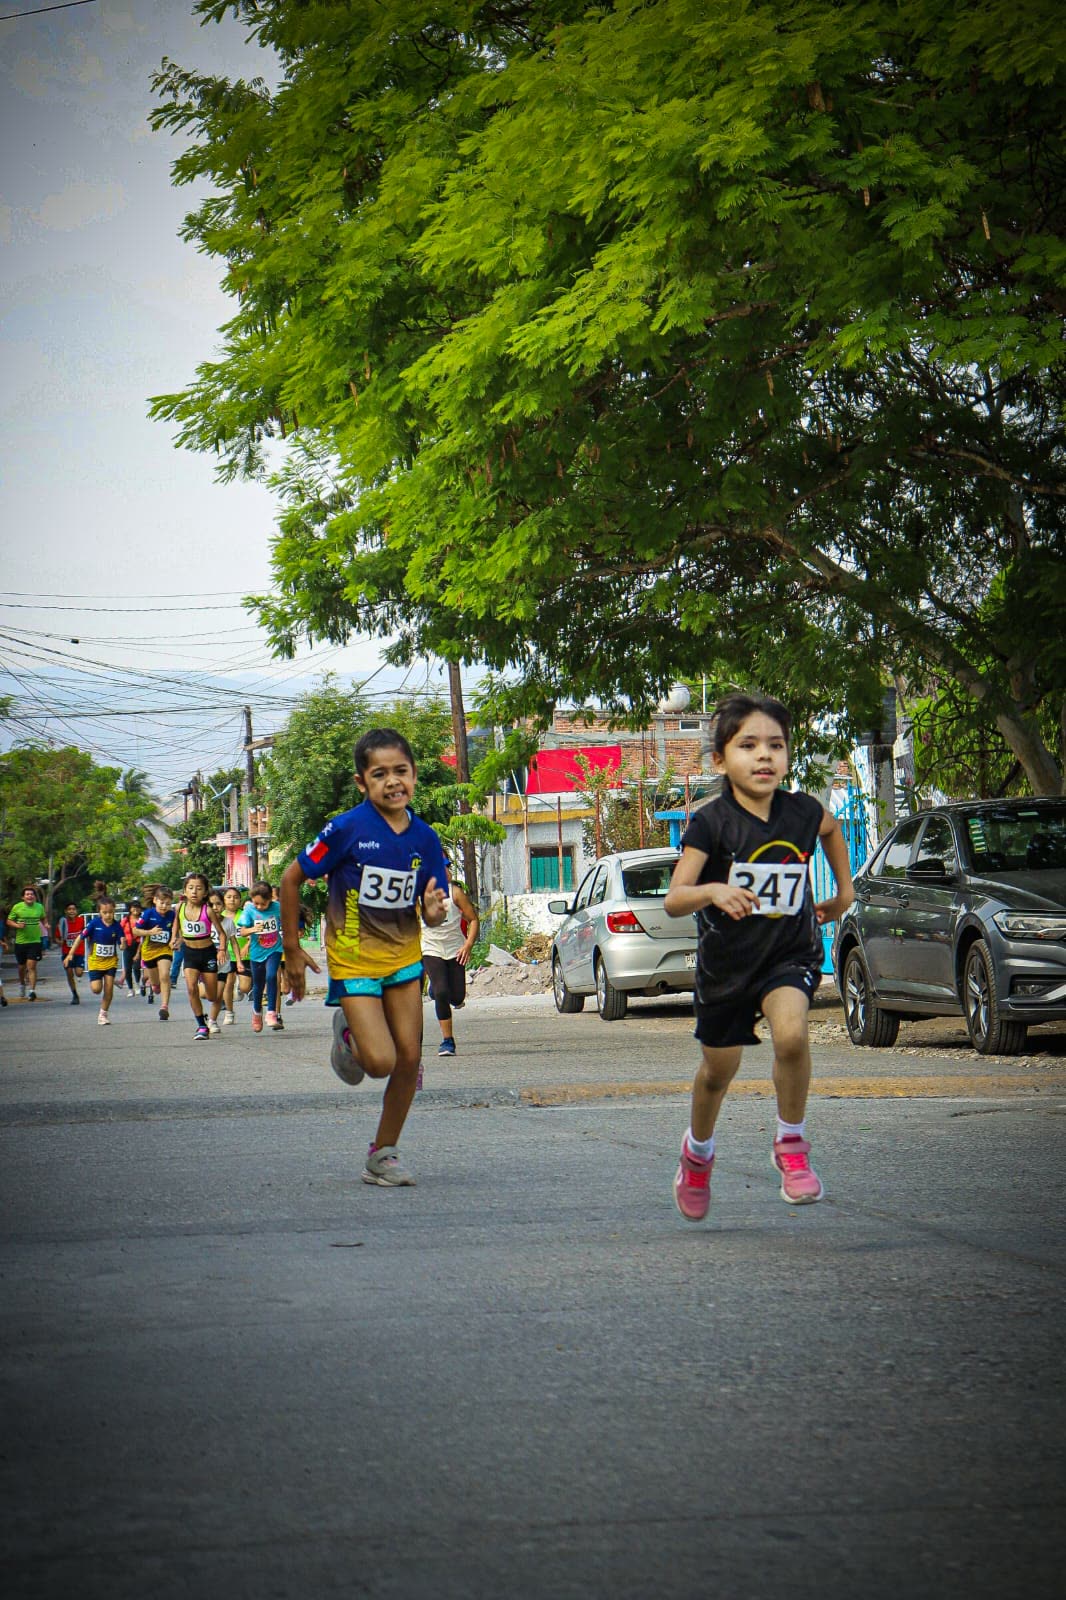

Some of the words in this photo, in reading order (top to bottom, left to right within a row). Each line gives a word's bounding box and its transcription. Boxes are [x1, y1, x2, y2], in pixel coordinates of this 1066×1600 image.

[363, 873, 414, 904] 356
[735, 871, 802, 907] 347
[187, 923, 201, 933] 90
[96, 945, 113, 955] 351
